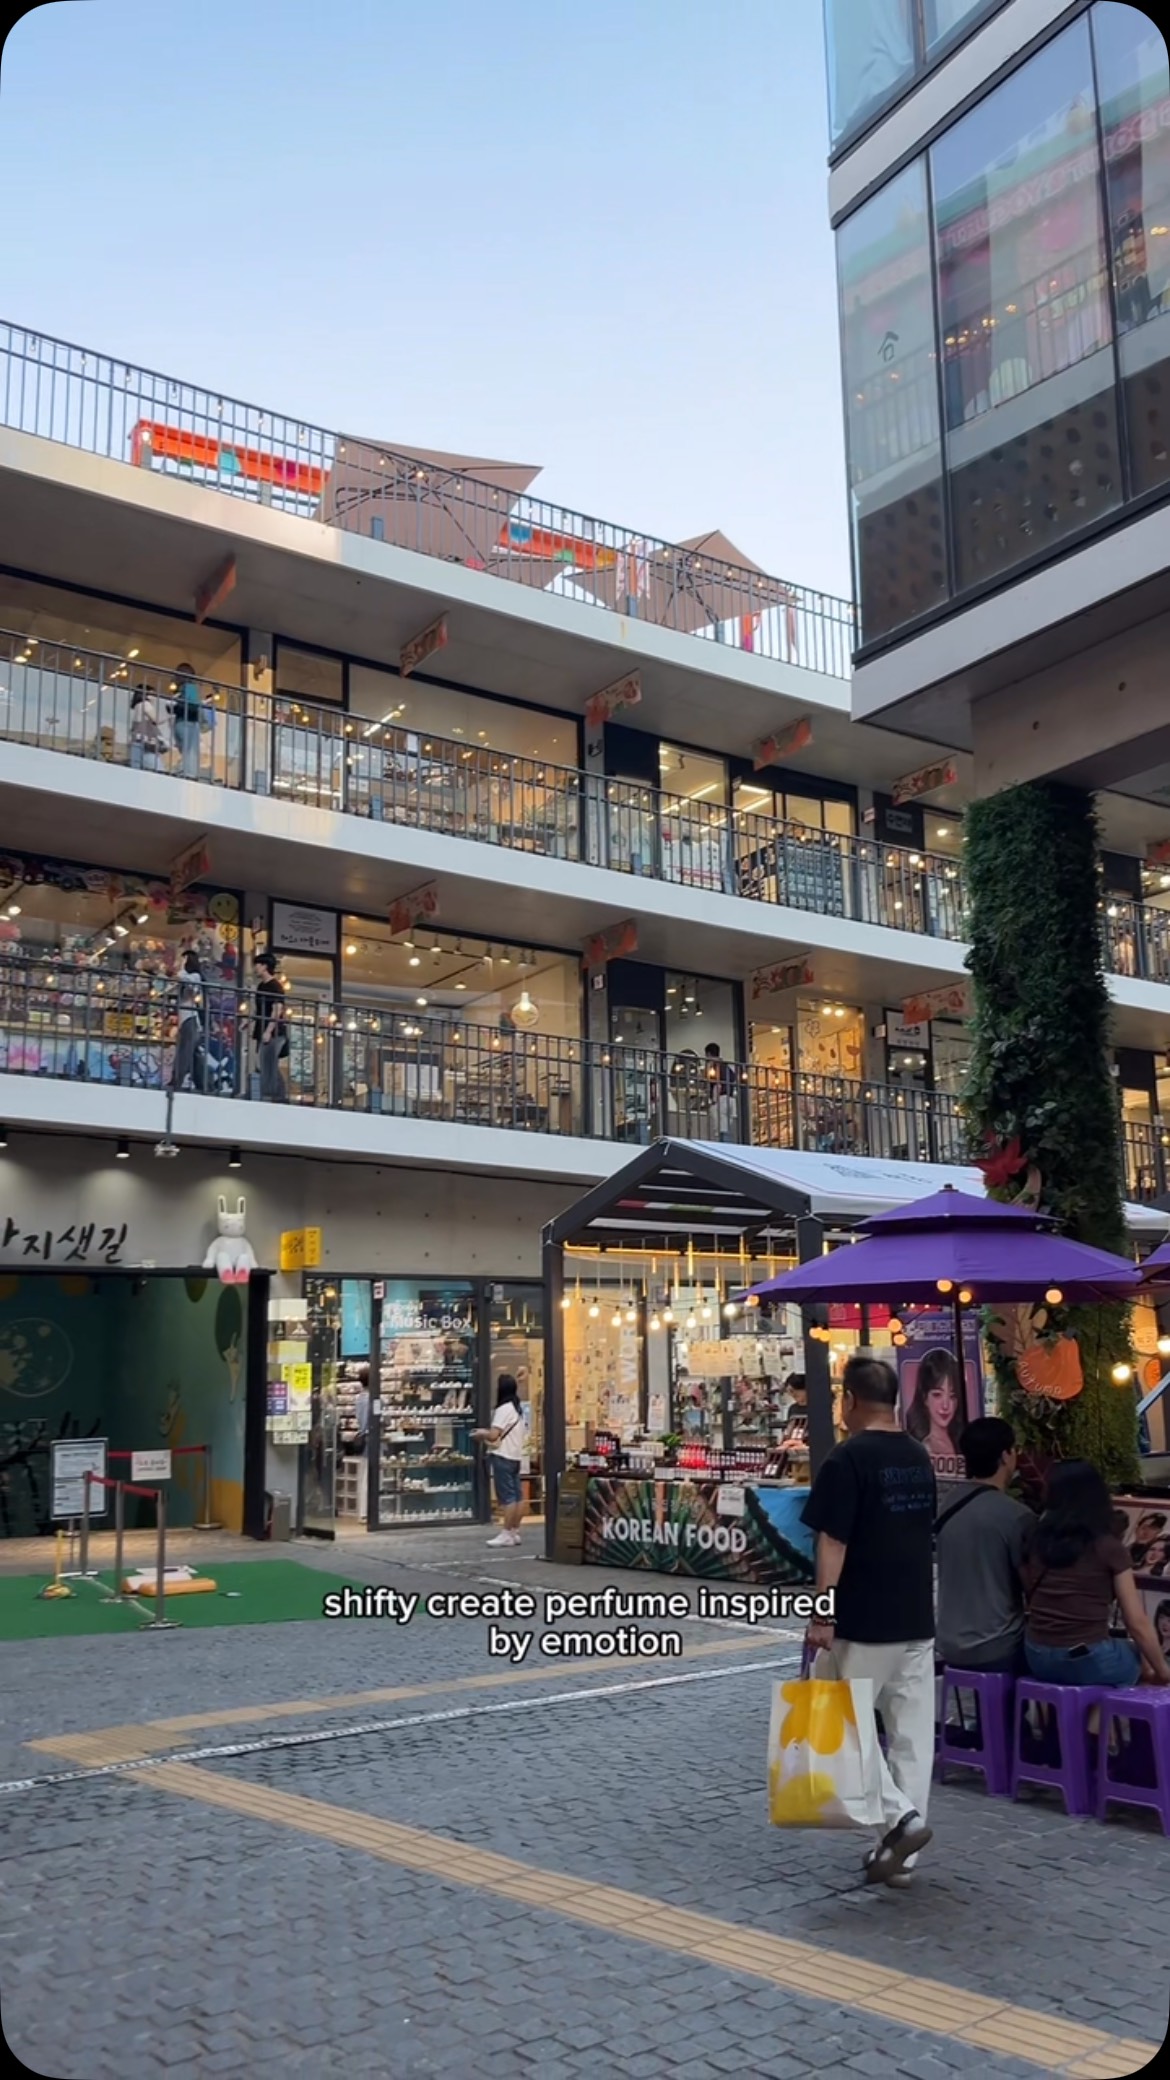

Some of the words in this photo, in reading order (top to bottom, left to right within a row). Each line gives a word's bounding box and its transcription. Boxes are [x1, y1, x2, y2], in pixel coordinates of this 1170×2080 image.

[441, 1315, 471, 1331] Box
[602, 1516, 679, 1546] KOREAN
[685, 1523, 748, 1553] FOOD
